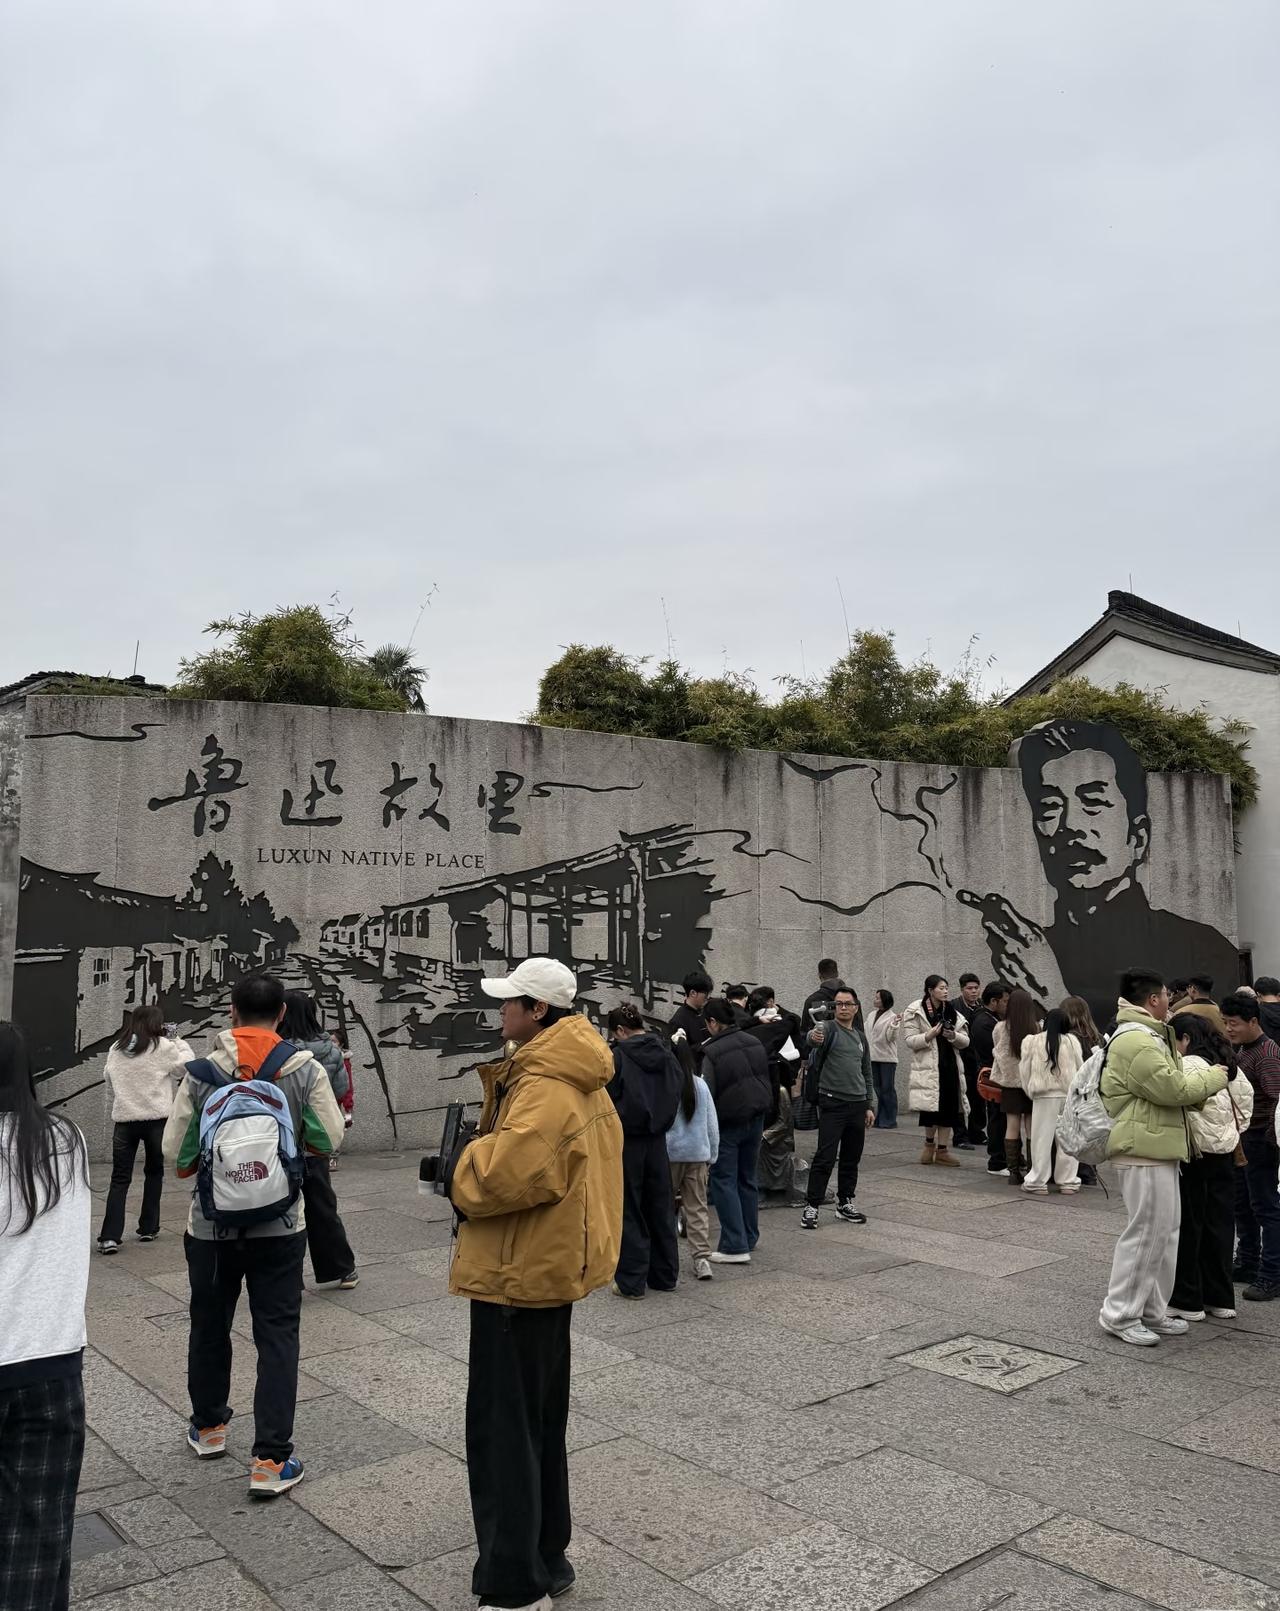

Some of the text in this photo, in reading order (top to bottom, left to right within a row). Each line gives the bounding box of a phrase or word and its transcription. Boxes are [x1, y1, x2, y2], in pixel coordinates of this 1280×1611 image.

[257, 847, 485, 869] LUXUN NATIVE PLACE
[237, 1161, 253, 1170] THE
[225, 1168, 254, 1178] NORTH
[233, 1175, 254, 1184] FACE
